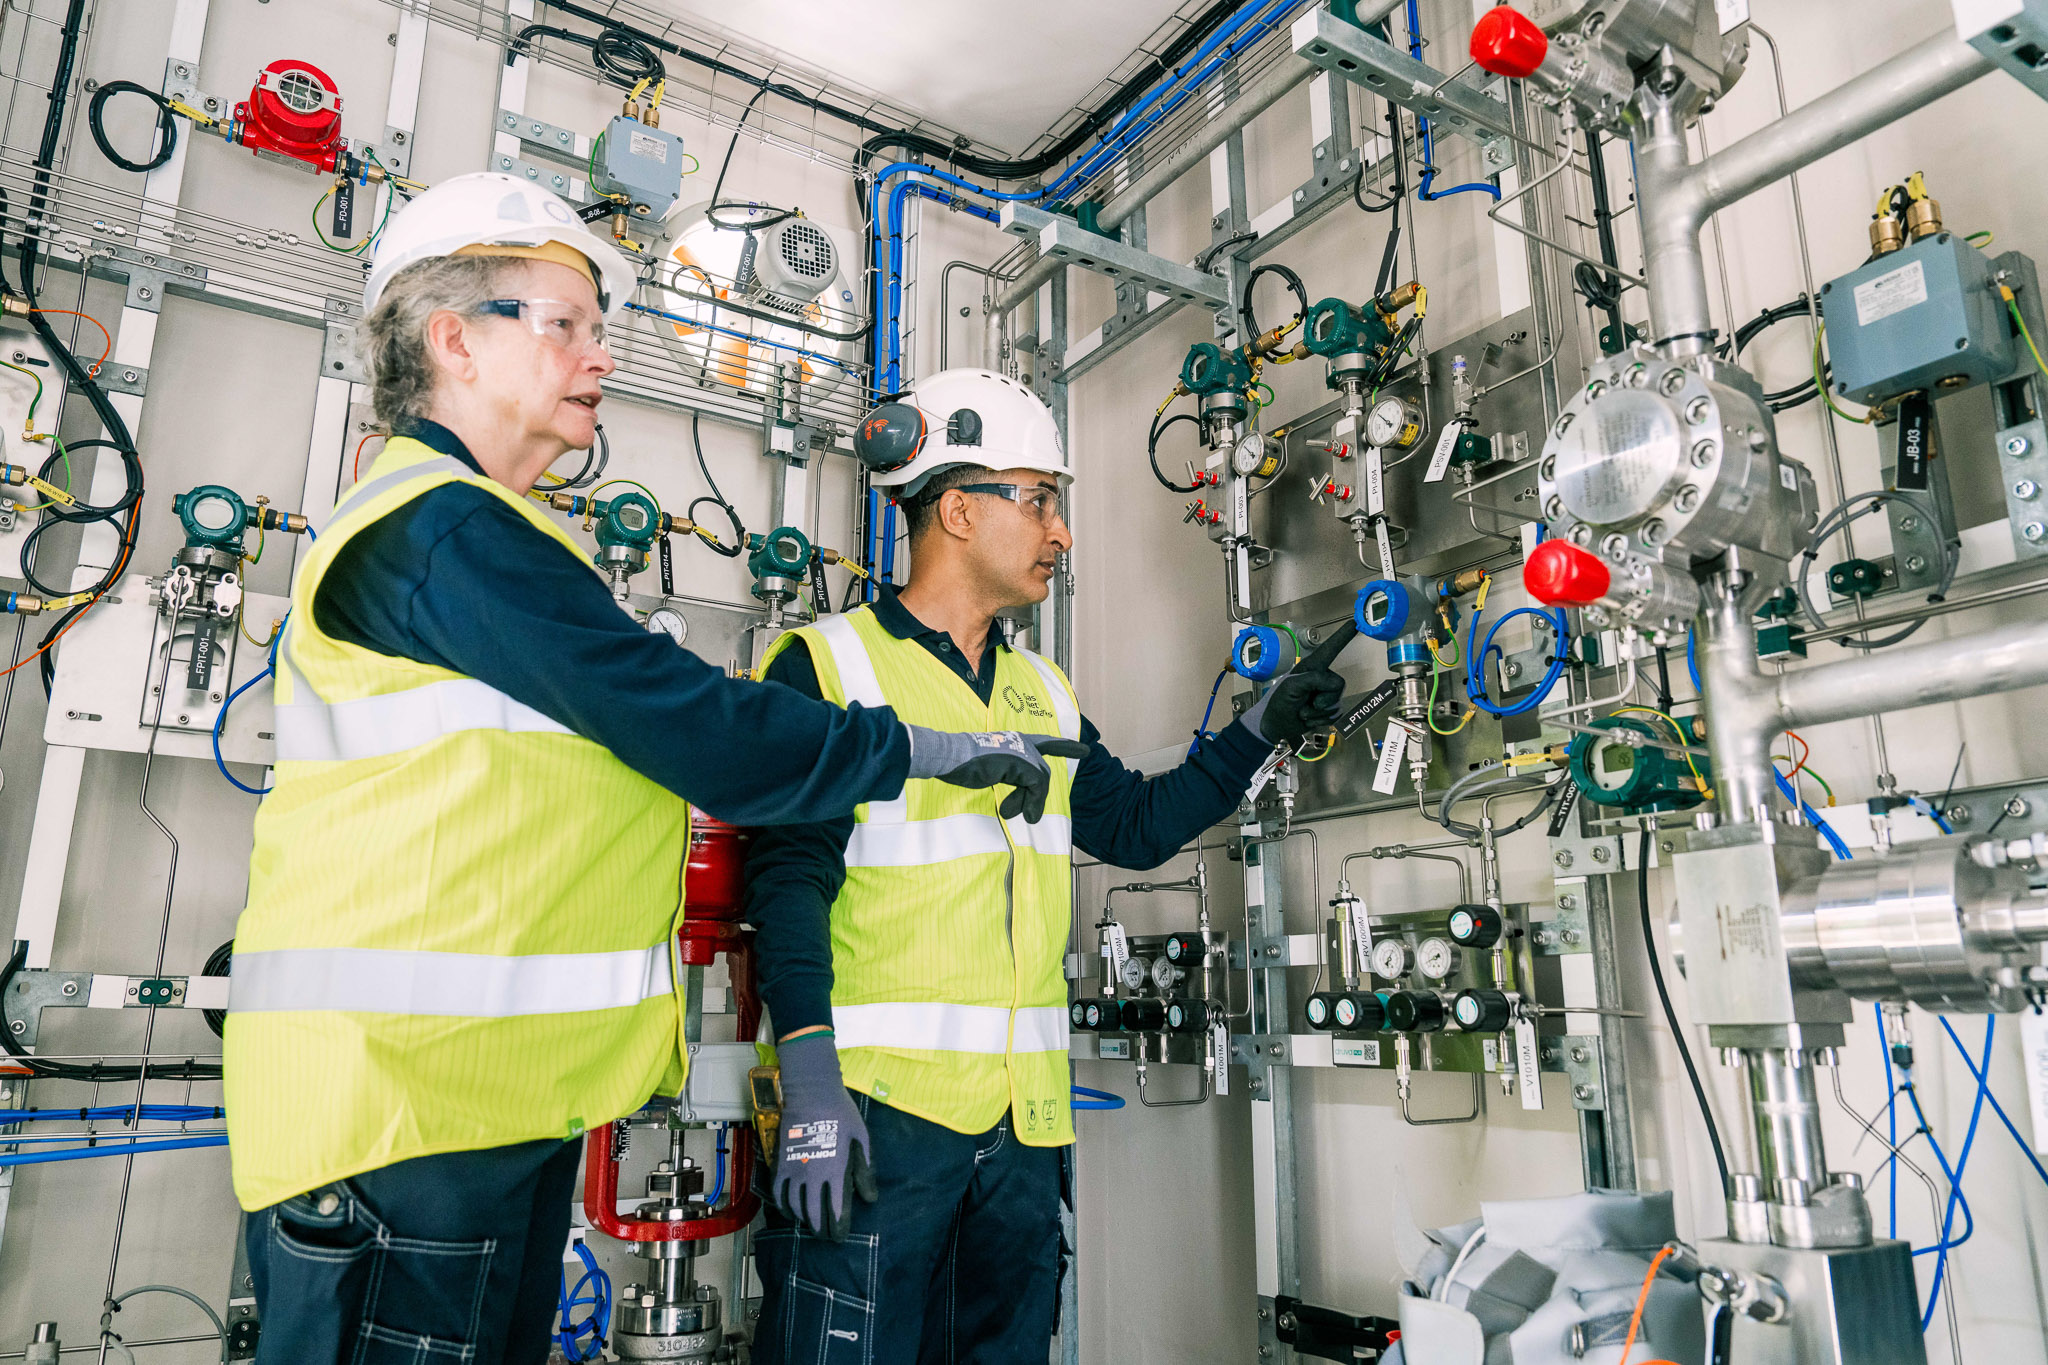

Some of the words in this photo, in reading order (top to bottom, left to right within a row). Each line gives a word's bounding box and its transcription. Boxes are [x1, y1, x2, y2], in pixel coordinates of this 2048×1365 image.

[339, 196, 348, 221] FD-001
[740, 253, 753, 282] EXT-001
[1434, 437, 1450, 468] PSV-001
[1905, 428, 1921, 461] JB-03
[1371, 469, 1379, 495] PI-004
[816, 577, 825, 600] PIT-005
[195, 636, 210, 674] FPIT-001
[1348, 693, 1385, 725] PT1012M
[1382, 740, 1398, 774] V1011M
[1357, 916, 1371, 958] RV1009M
[1523, 1045, 1534, 1087] V1010M
[786, 1149, 837, 1162] PORTWEST
